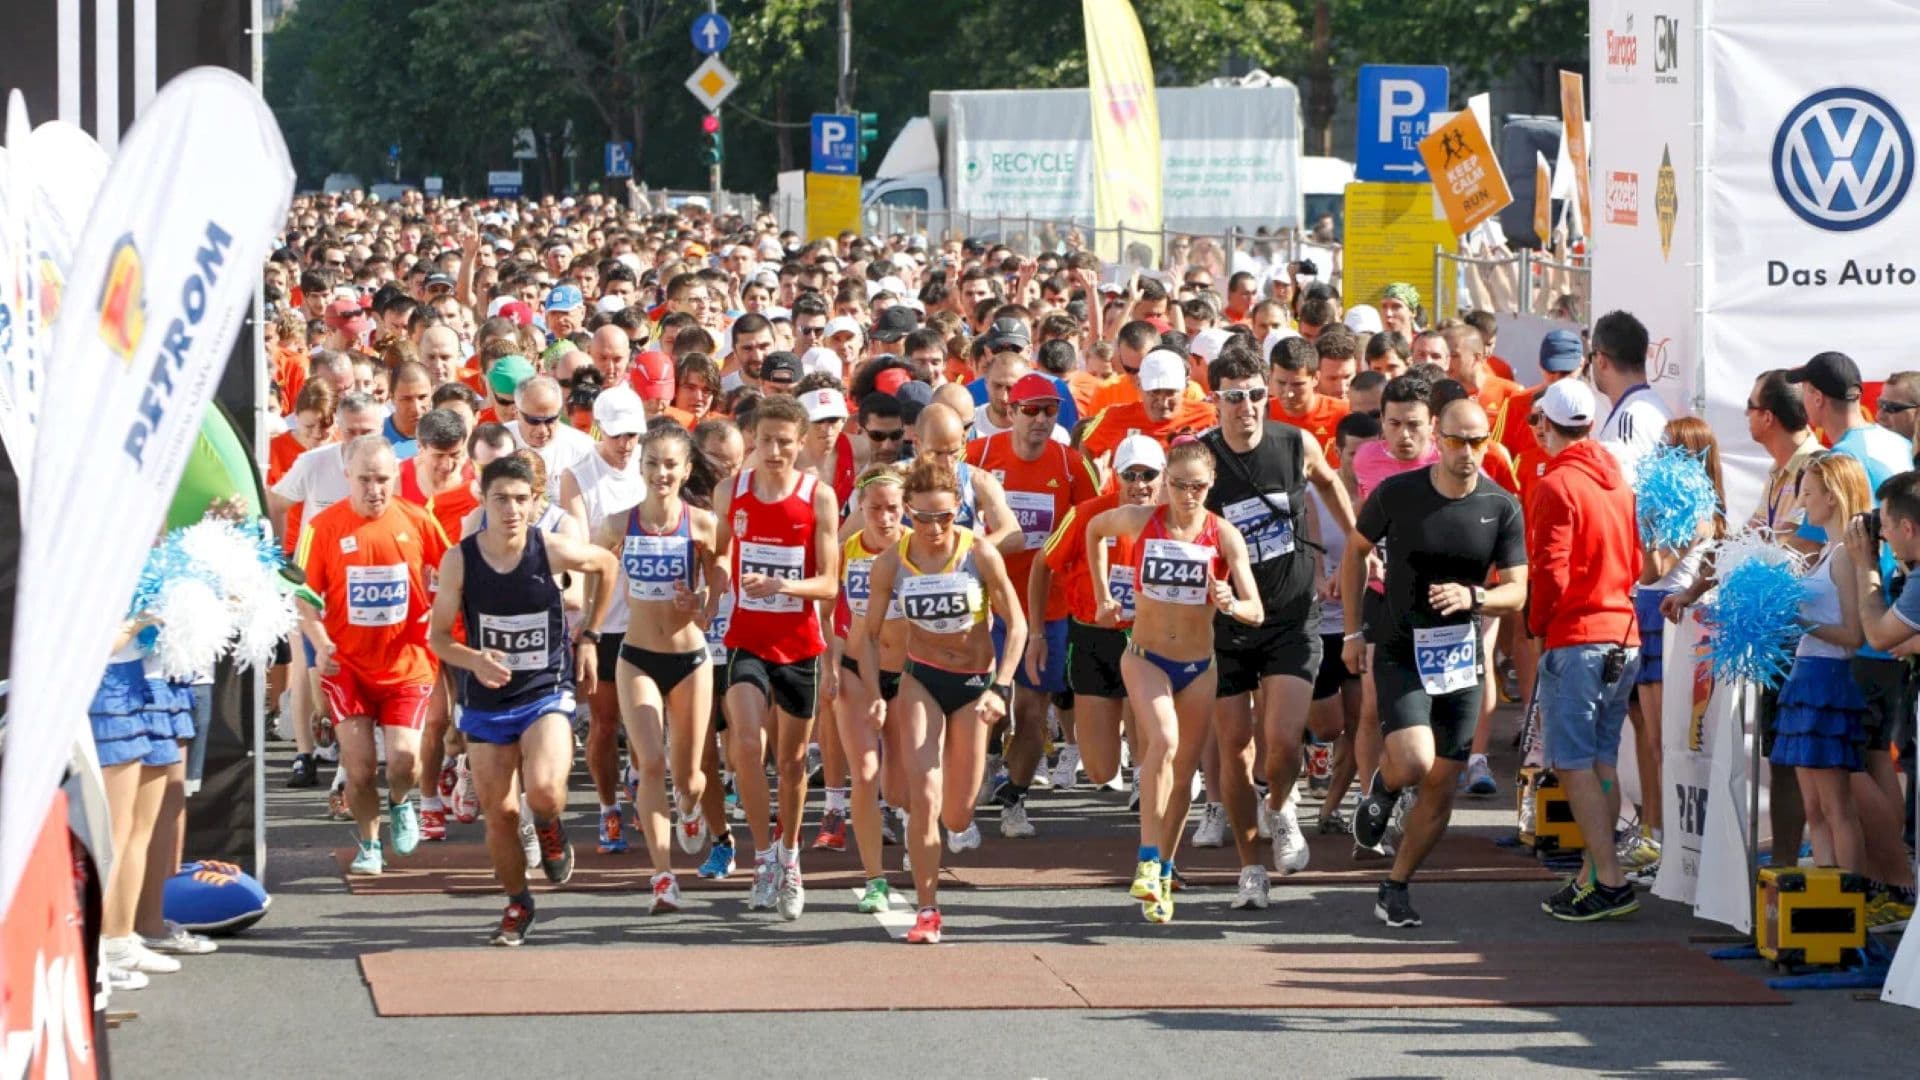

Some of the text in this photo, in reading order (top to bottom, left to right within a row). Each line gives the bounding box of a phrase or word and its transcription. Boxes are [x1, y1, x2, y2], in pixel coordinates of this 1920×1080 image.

[1378, 79, 1426, 143] P
[822, 121, 846, 155] P
[992, 152, 1073, 173] RECYCLE
[1447, 155, 1479, 182] KEEP
[1452, 167, 1485, 195] CALM
[1463, 189, 1489, 211] RUN
[1767, 260, 1827, 287] Das
[123, 220, 233, 473] PETROM
[626, 558, 684, 577] 2565
[1147, 560, 1204, 583] 1244
[352, 582, 406, 602] 2044
[907, 596, 965, 617] 1245
[487, 631, 545, 650] 1168
[1421, 644, 1473, 669] 2360
